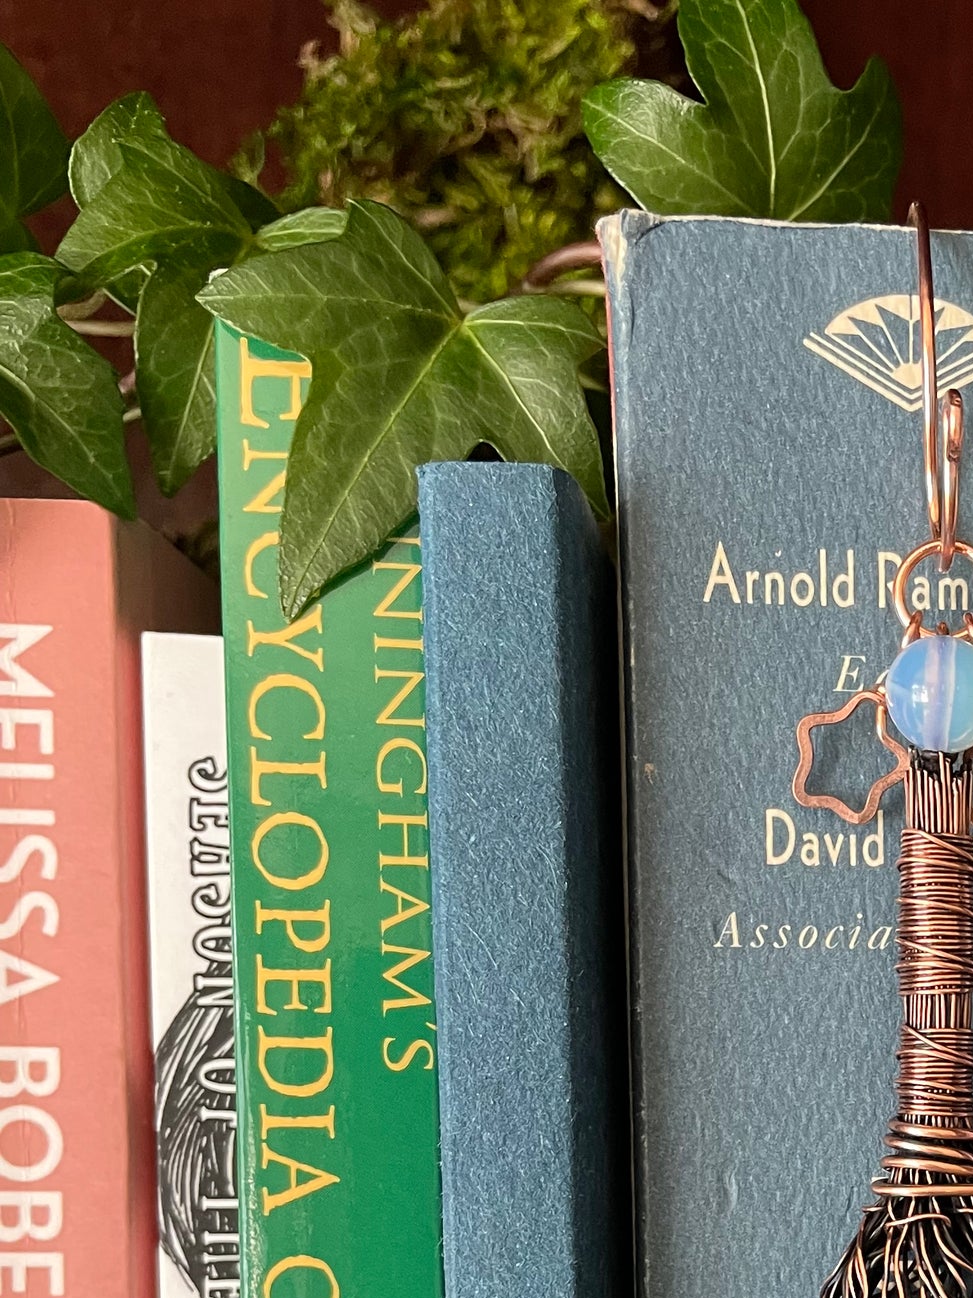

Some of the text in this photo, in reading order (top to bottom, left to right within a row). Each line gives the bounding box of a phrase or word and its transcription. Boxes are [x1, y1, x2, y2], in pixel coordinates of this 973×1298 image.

[702, 541, 855, 608] Arnold
[766, 809, 885, 868] David
[0, 1045, 64, 1297] BOBE
